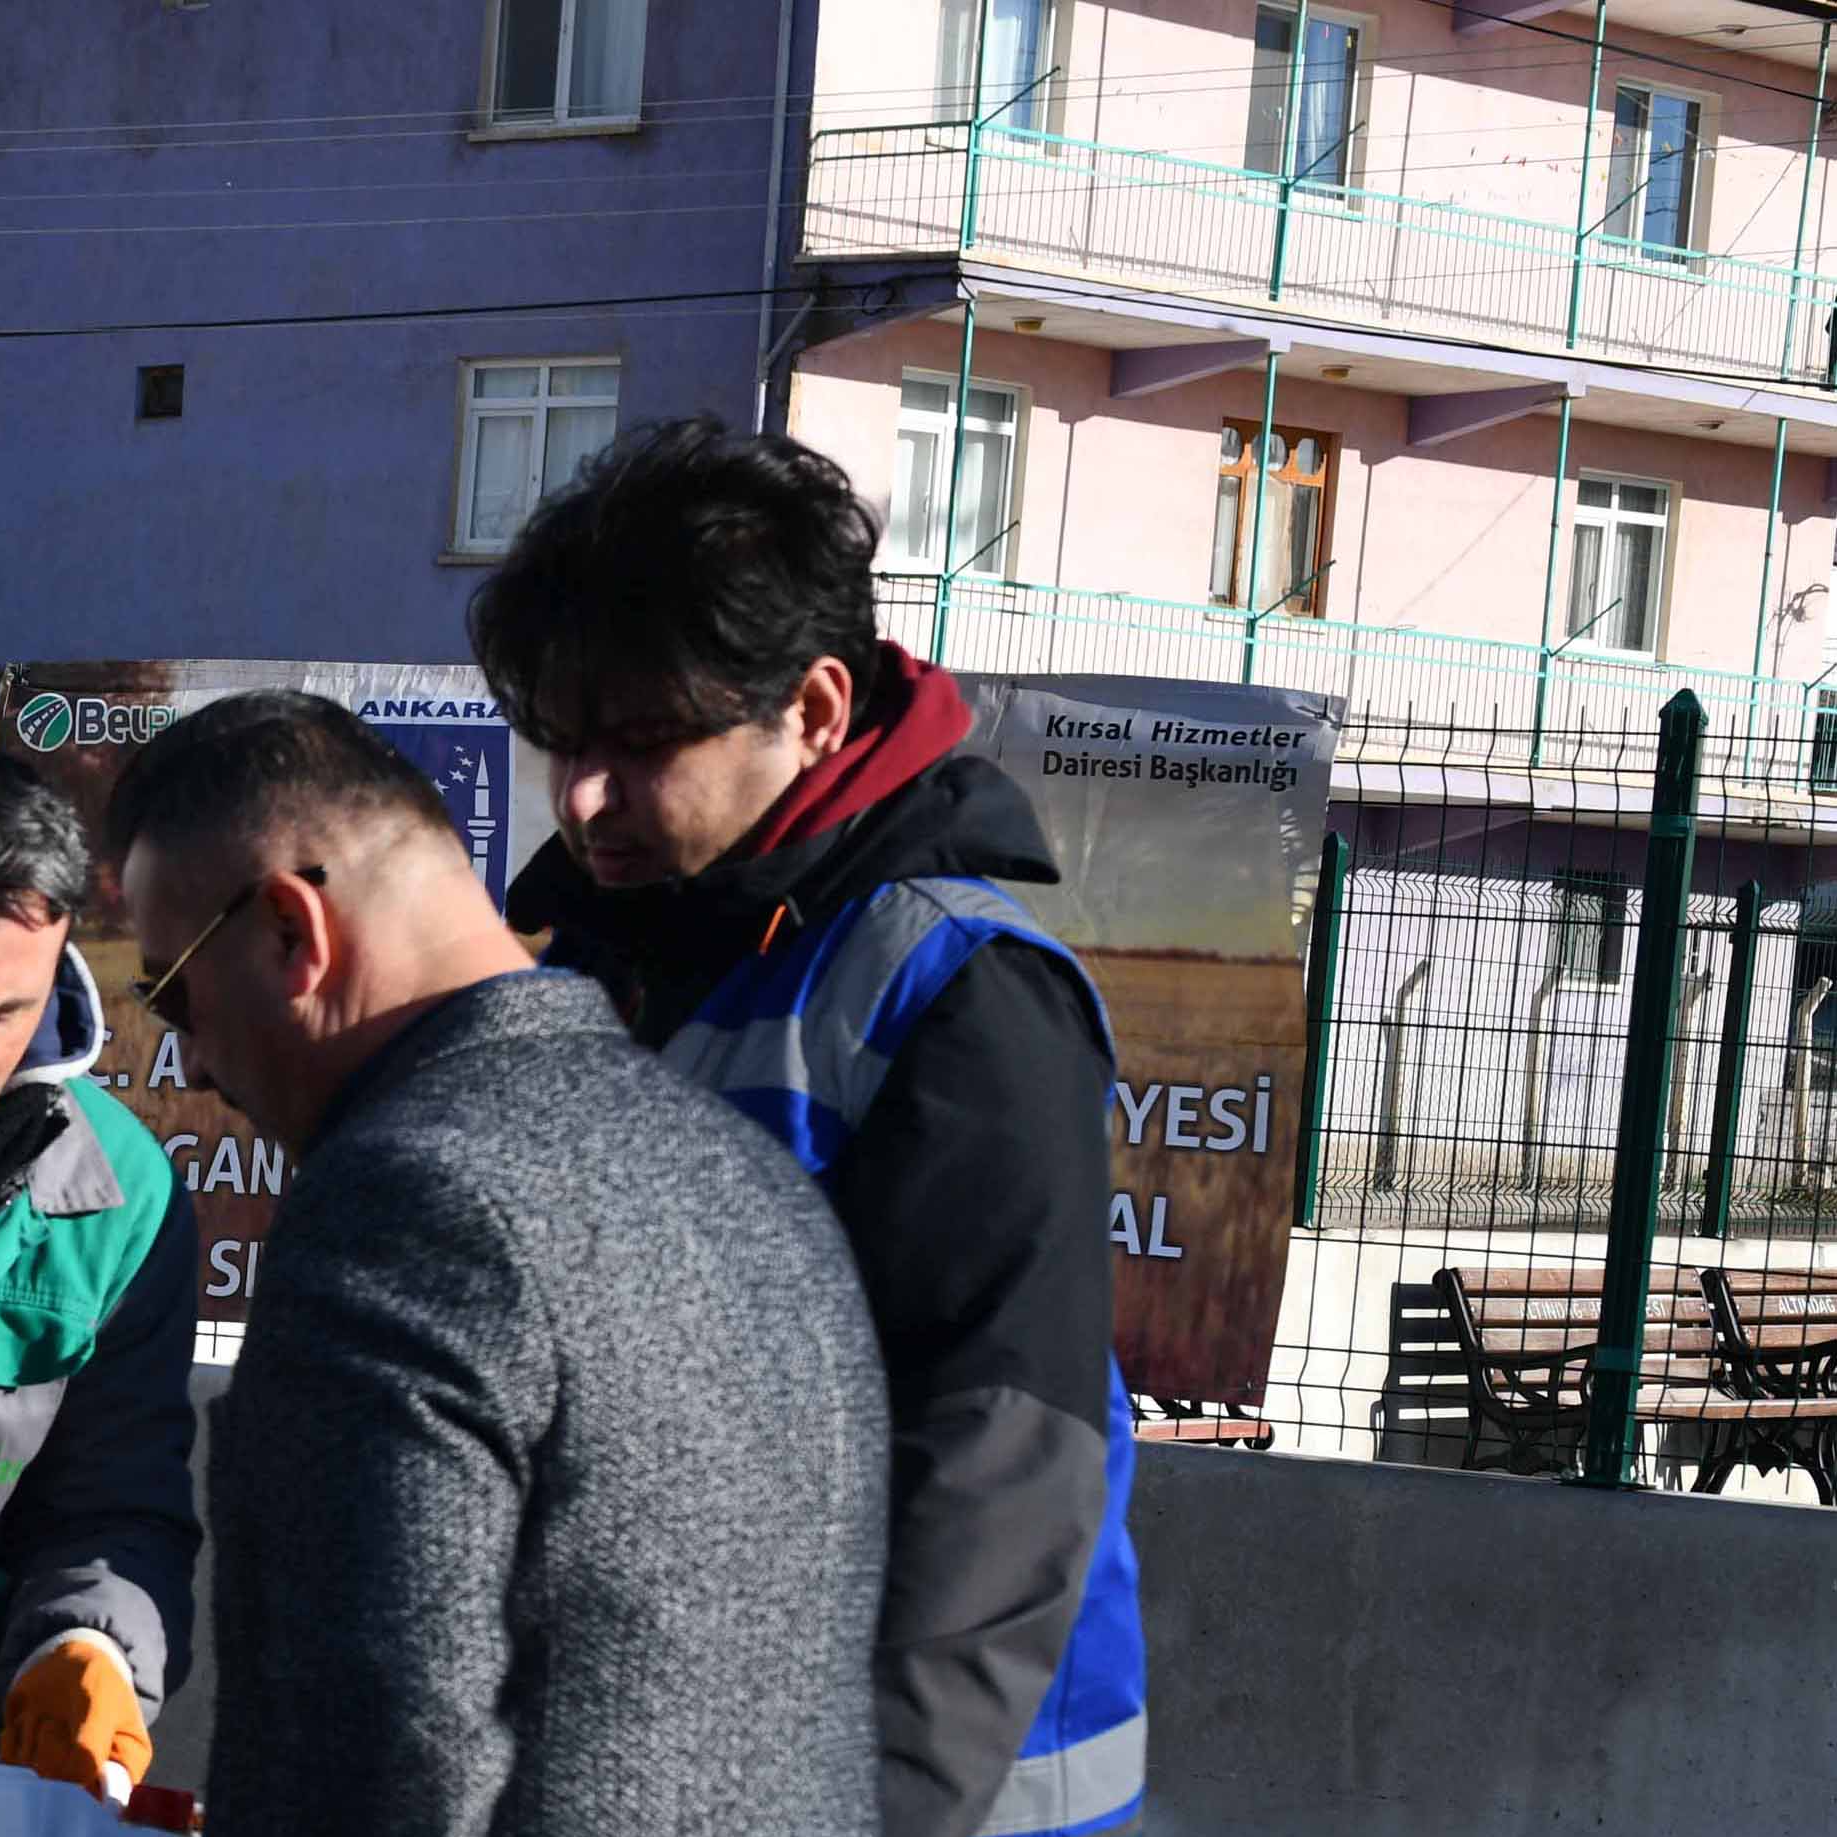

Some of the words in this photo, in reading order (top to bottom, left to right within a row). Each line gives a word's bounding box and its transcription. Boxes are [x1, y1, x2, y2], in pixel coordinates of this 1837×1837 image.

[1045, 714, 1132, 740] Kırsal
[1150, 720, 1307, 748] Hizmetler
[1042, 750, 1142, 780] Dairesi
[1149, 755, 1298, 791] Başkanlığı
